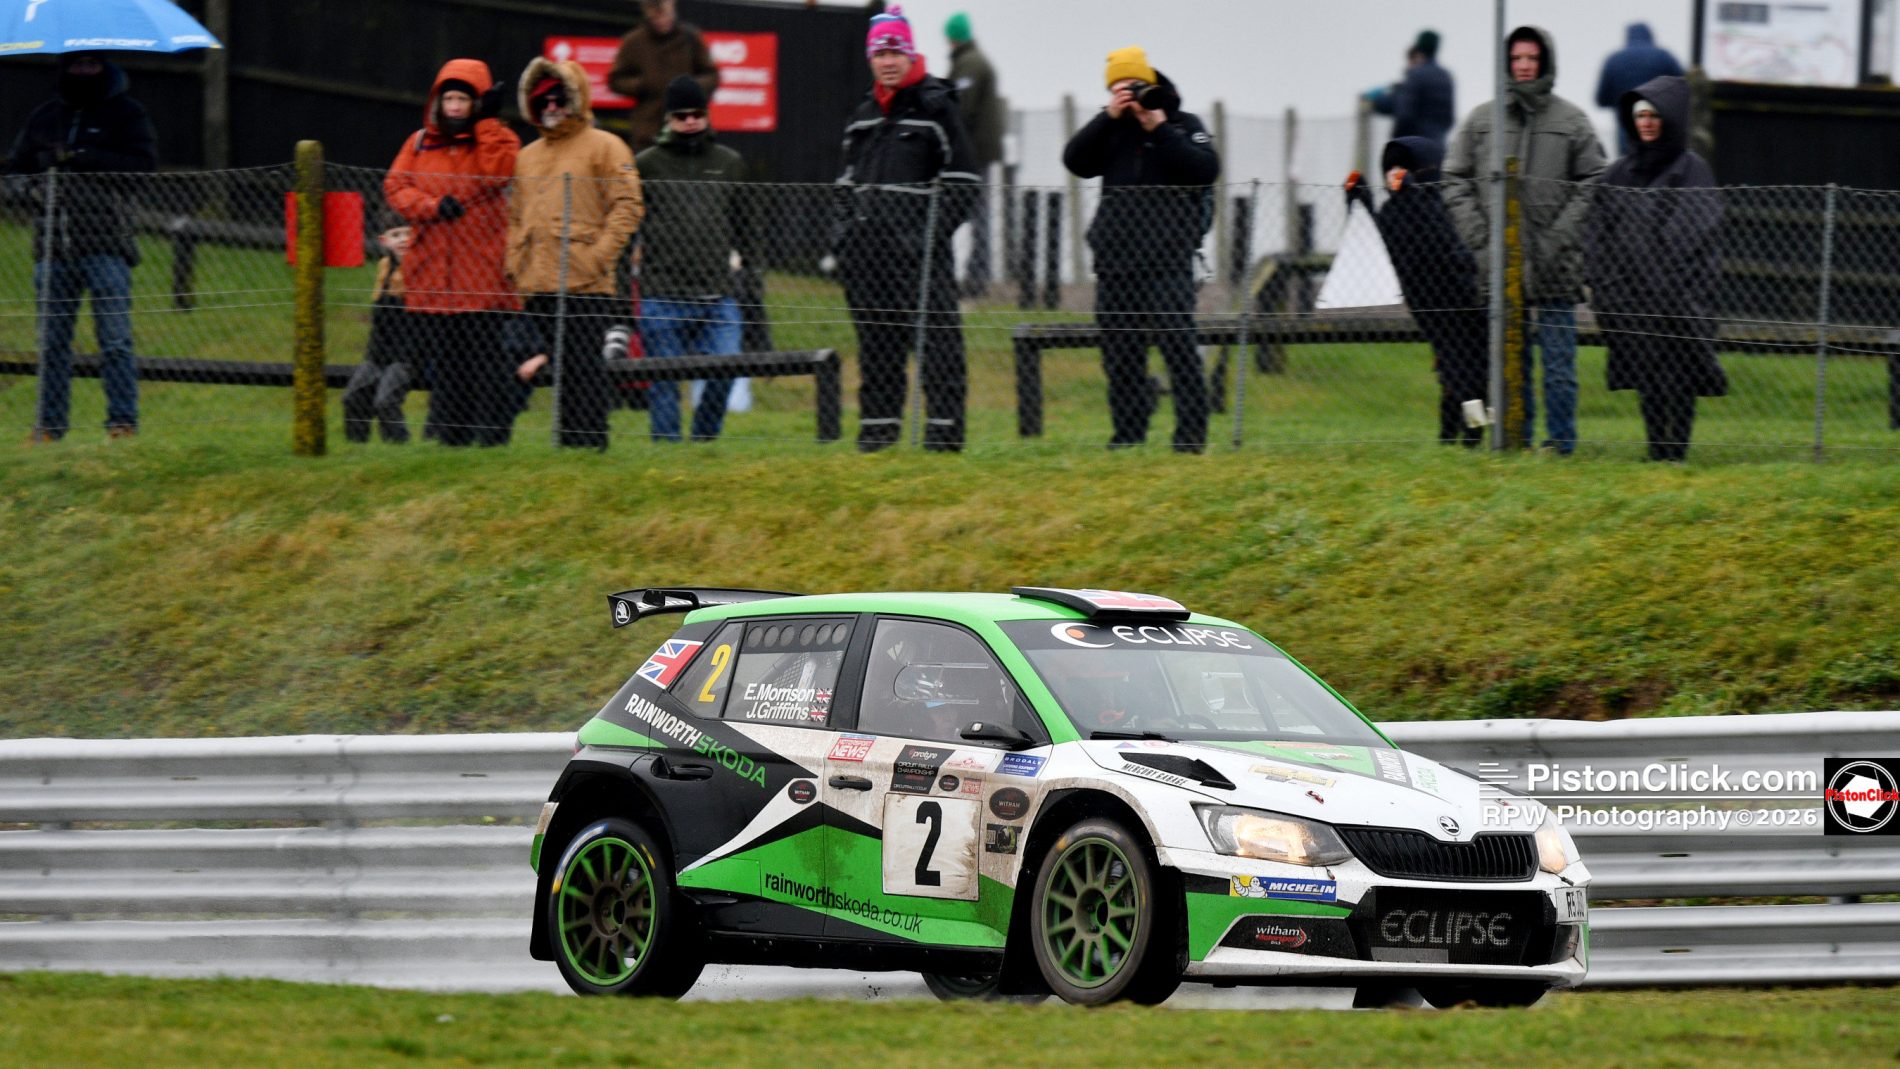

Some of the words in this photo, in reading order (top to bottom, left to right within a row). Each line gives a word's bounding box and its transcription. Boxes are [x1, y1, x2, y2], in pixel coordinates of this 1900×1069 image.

[1112, 625, 1252, 650] ECLIPSE
[698, 644, 731, 703] 2
[831, 744, 869, 759] NEWS
[912, 750, 938, 760] protyre
[1123, 763, 1158, 777] MERCURY
[1156, 772, 1188, 787] GARAGE
[915, 801, 942, 886] 2
[1269, 882, 1336, 894] MICHELIN
[764, 872, 924, 935] rainworthskoda.co.uk
[1256, 925, 1300, 936] witham
[1381, 910, 1512, 946] ECLIPSE
